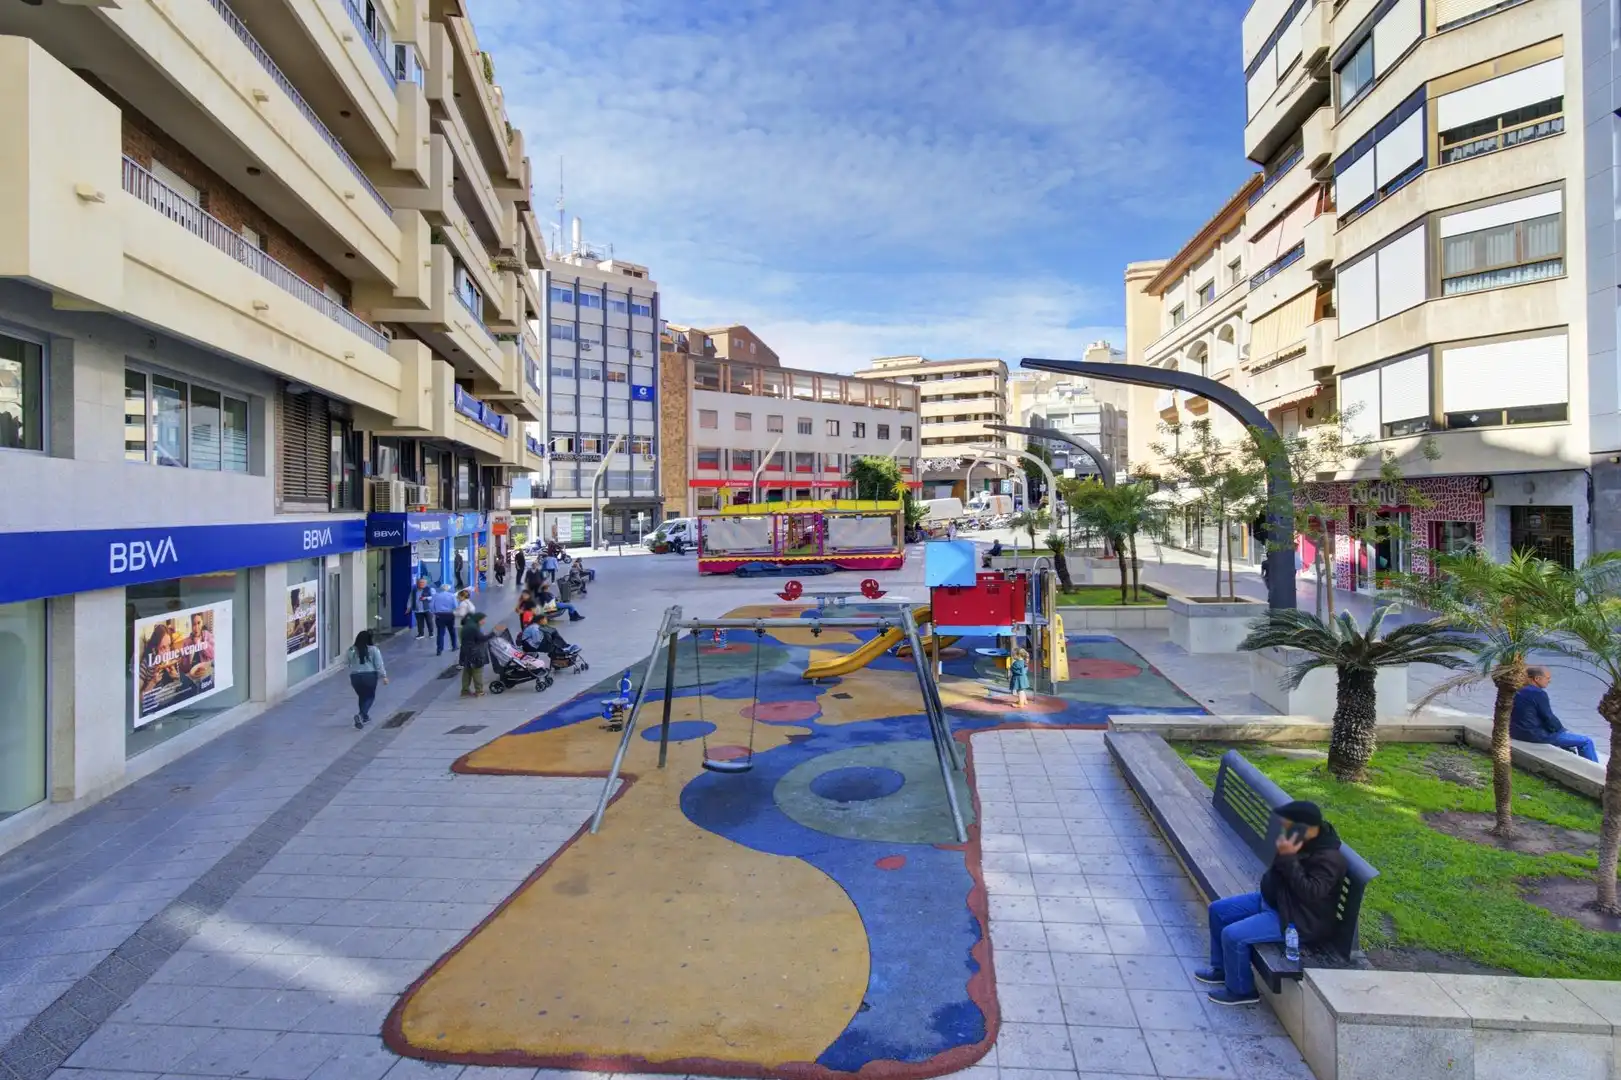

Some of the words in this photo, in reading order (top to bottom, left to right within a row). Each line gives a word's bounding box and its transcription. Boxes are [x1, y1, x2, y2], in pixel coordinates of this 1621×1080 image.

[303, 527, 333, 550] BBVA
[373, 530, 401, 538] BBVA
[109, 535, 178, 574] BBVA
[148, 653, 162, 667] Lo
[163, 648, 179, 664] que
